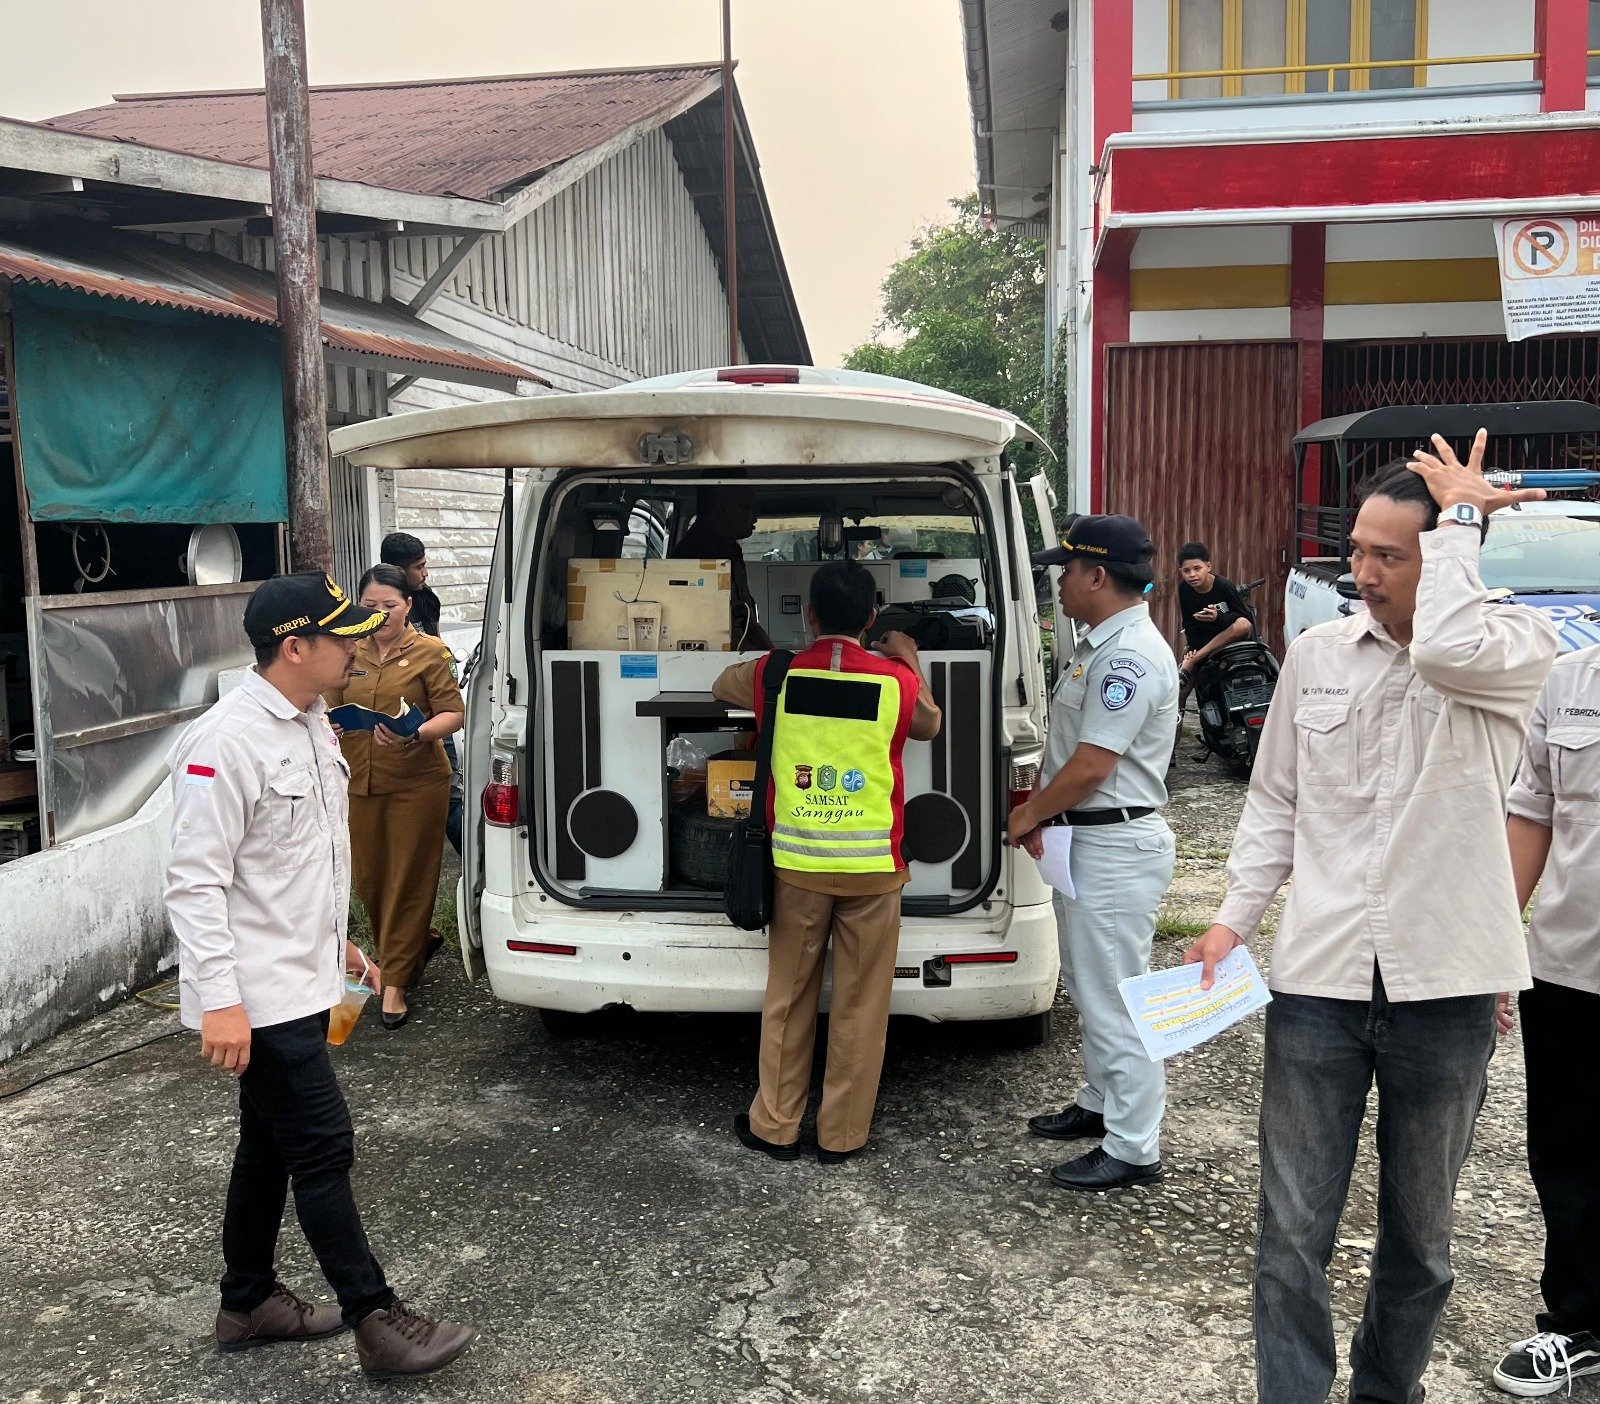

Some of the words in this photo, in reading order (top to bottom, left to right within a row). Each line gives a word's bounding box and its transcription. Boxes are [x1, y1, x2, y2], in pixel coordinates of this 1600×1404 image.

[272, 615, 311, 636] KORPRI
[805, 794, 848, 806] SAMSAT
[790, 806, 864, 824] Sanggau
